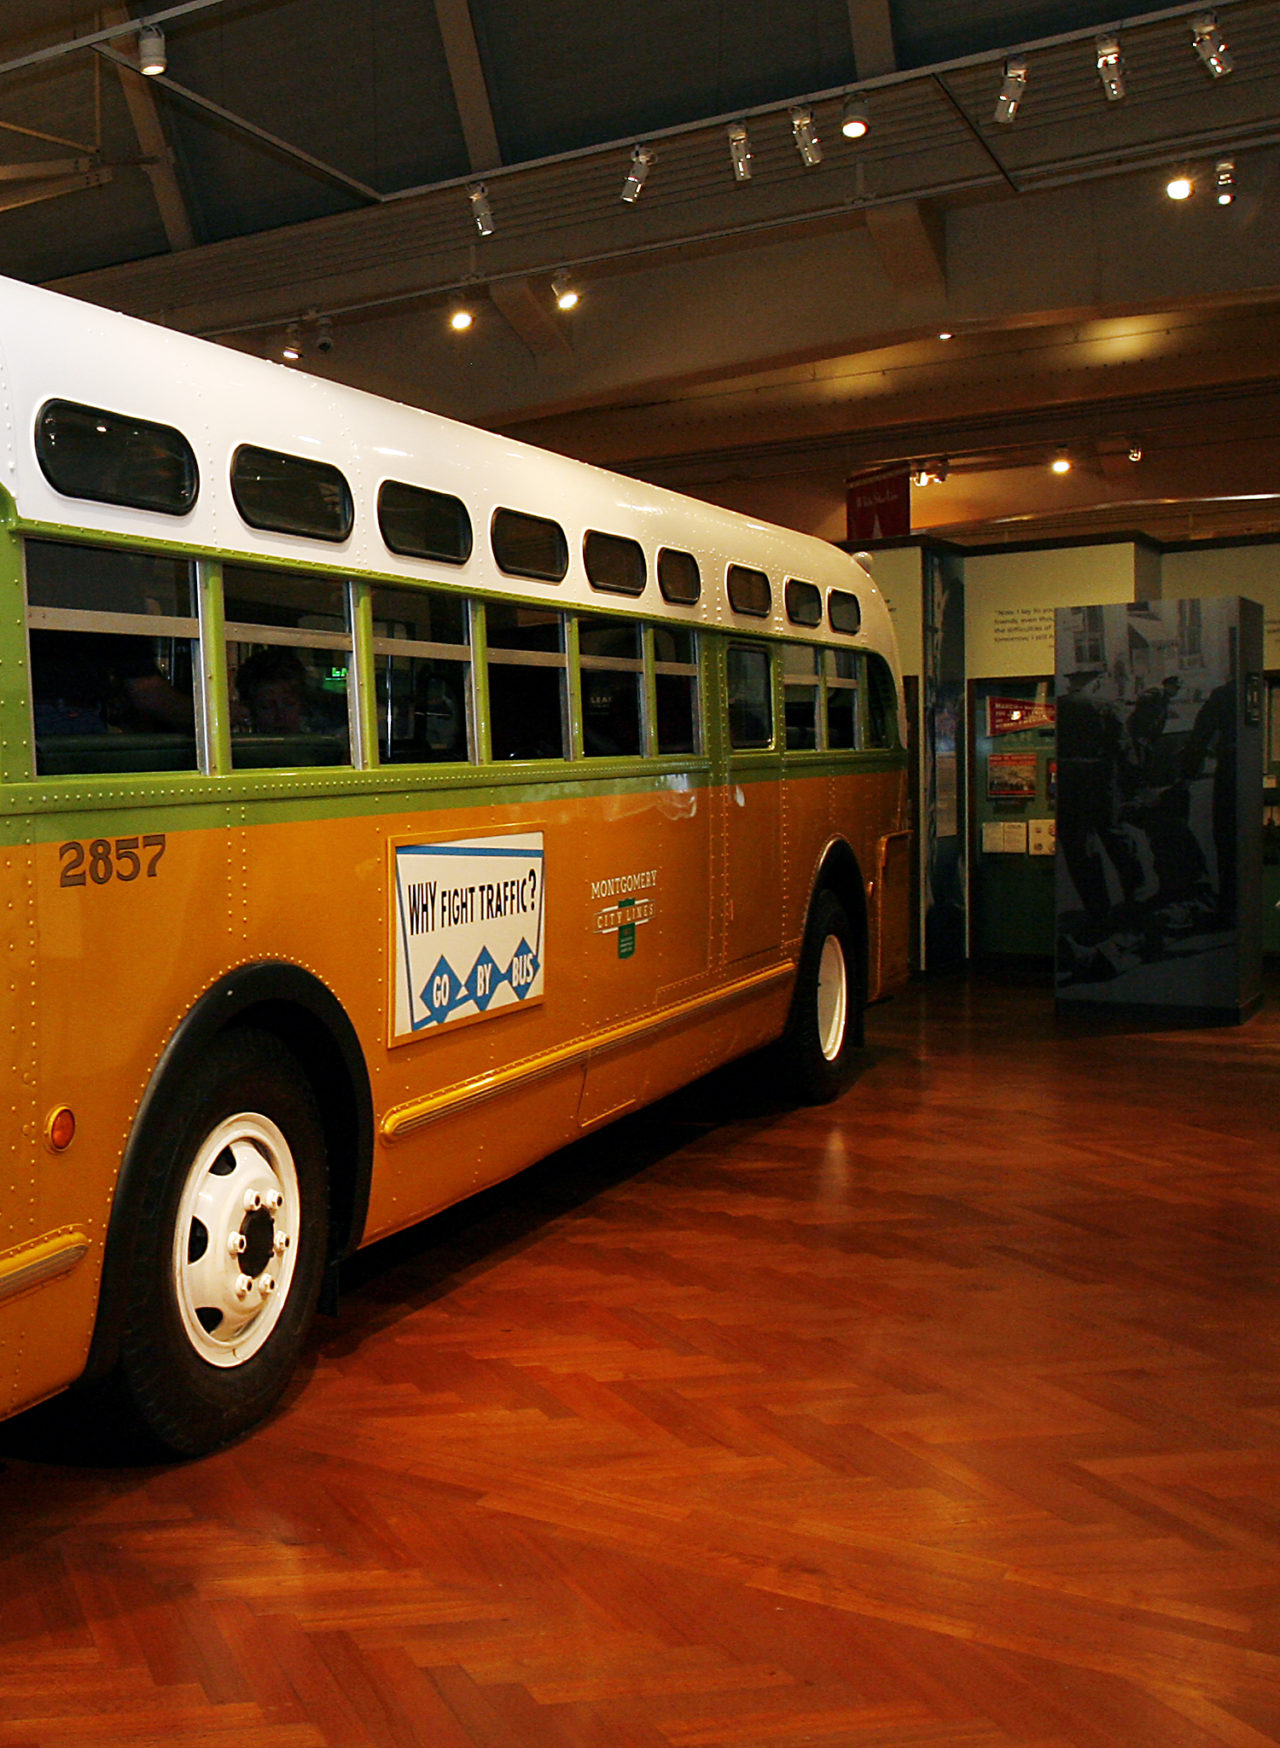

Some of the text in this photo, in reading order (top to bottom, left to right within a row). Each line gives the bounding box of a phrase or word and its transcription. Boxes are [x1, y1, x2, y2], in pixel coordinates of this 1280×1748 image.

[59, 834, 166, 888] 2857
[591, 870, 657, 900] MONTGOMERY
[408, 868, 536, 936] WHY FIGHT TRAFFIC?
[597, 903, 654, 929] CITY LINES
[433, 953, 534, 1008] GO BY BUS
